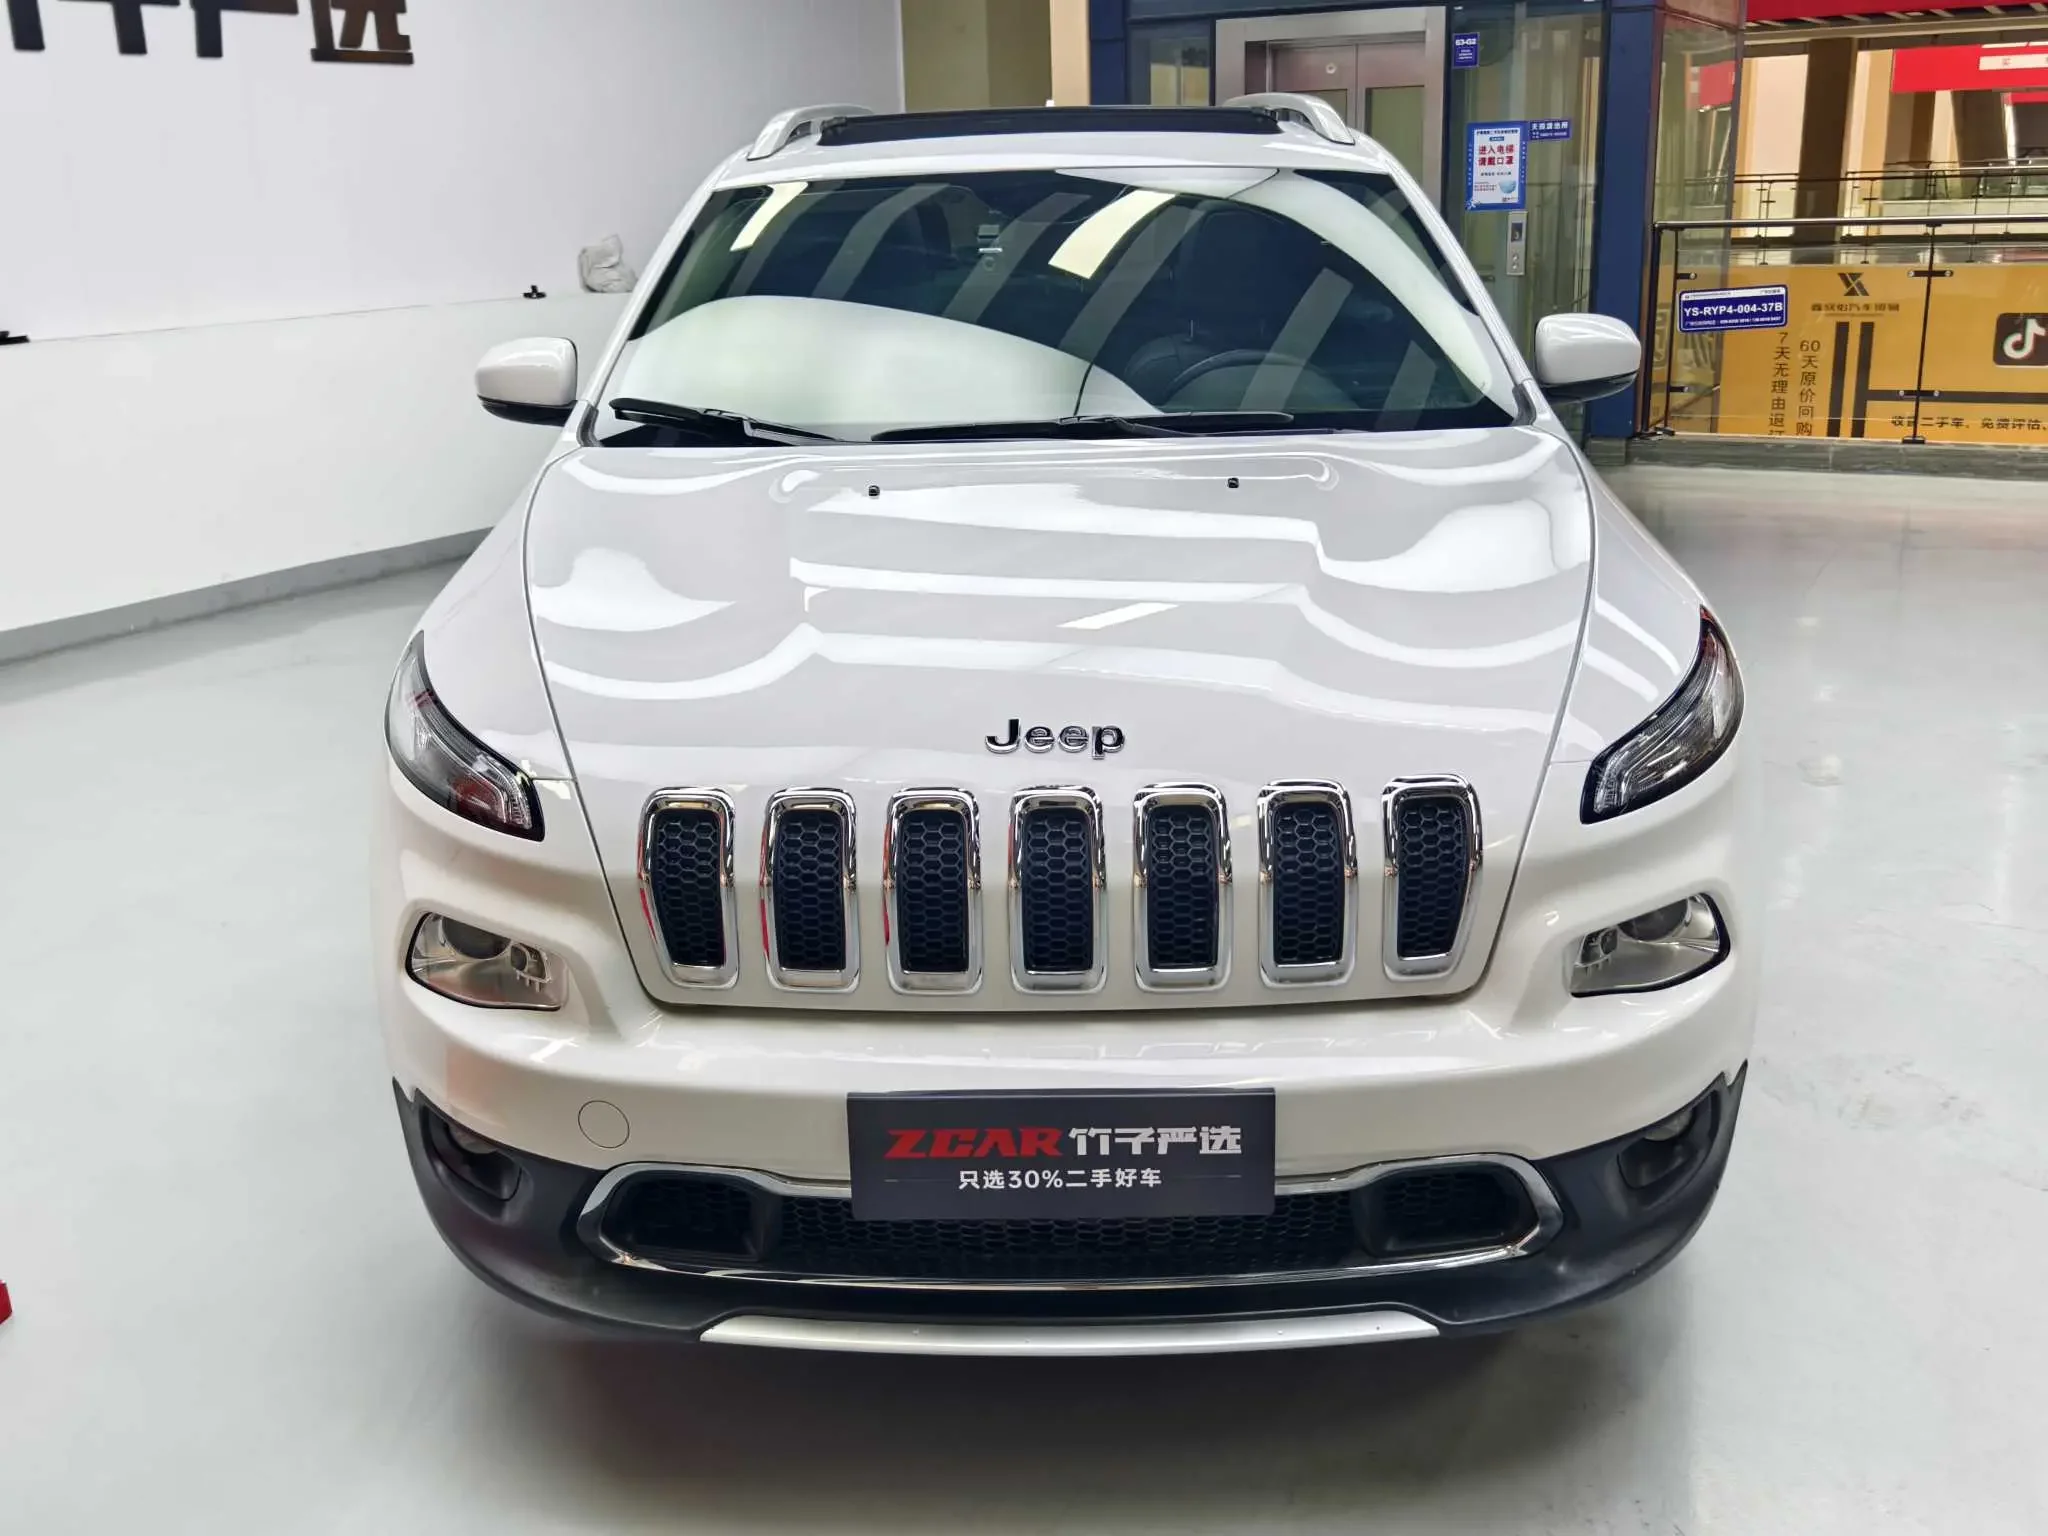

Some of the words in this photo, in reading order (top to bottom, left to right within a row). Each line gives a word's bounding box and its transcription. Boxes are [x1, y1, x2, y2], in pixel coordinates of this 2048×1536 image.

[1478, 144, 1515, 155] 进入电梯
[1684, 302, 1784, 317] YS-RYP4-004-37B
[1796, 340, 1821, 437] 60天原价回购
[985, 718, 1125, 760] Jeep
[884, 1126, 1063, 1159] ZCAR
[1068, 1125, 1242, 1155] 竹子严选
[959, 1168, 1162, 1190] 只选30%二手好车
